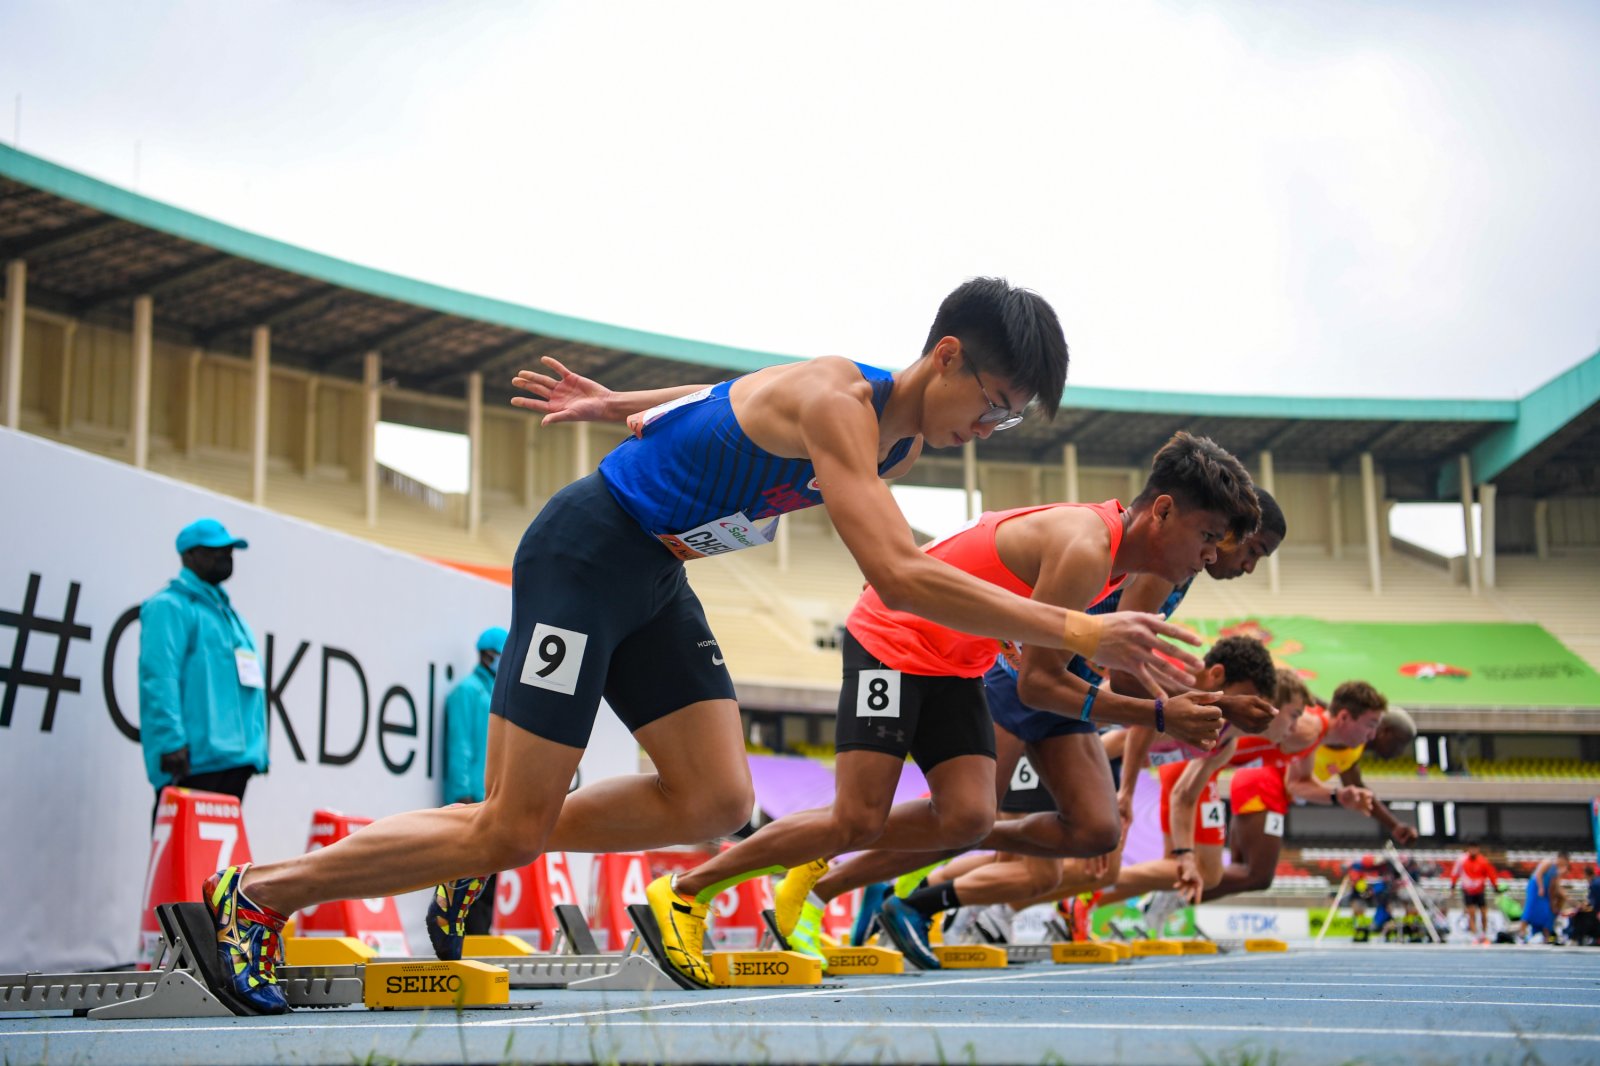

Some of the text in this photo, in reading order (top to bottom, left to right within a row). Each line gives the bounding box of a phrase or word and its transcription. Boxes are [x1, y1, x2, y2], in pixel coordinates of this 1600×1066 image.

[683, 531, 736, 557] CHE
[535, 634, 567, 678] 9
[867, 677, 890, 711] 8
[1019, 764, 1032, 783] 6
[195, 801, 240, 819] MONDO
[1208, 806, 1220, 823] 4
[198, 821, 239, 872] 7
[545, 851, 572, 905] 5
[621, 858, 649, 905] 4
[1242, 914, 1280, 932] TDK
[829, 955, 878, 967] SEIKO
[944, 951, 987, 962] SEIKO
[729, 962, 789, 976] SEIKO
[386, 975, 462, 993] SEIKO
